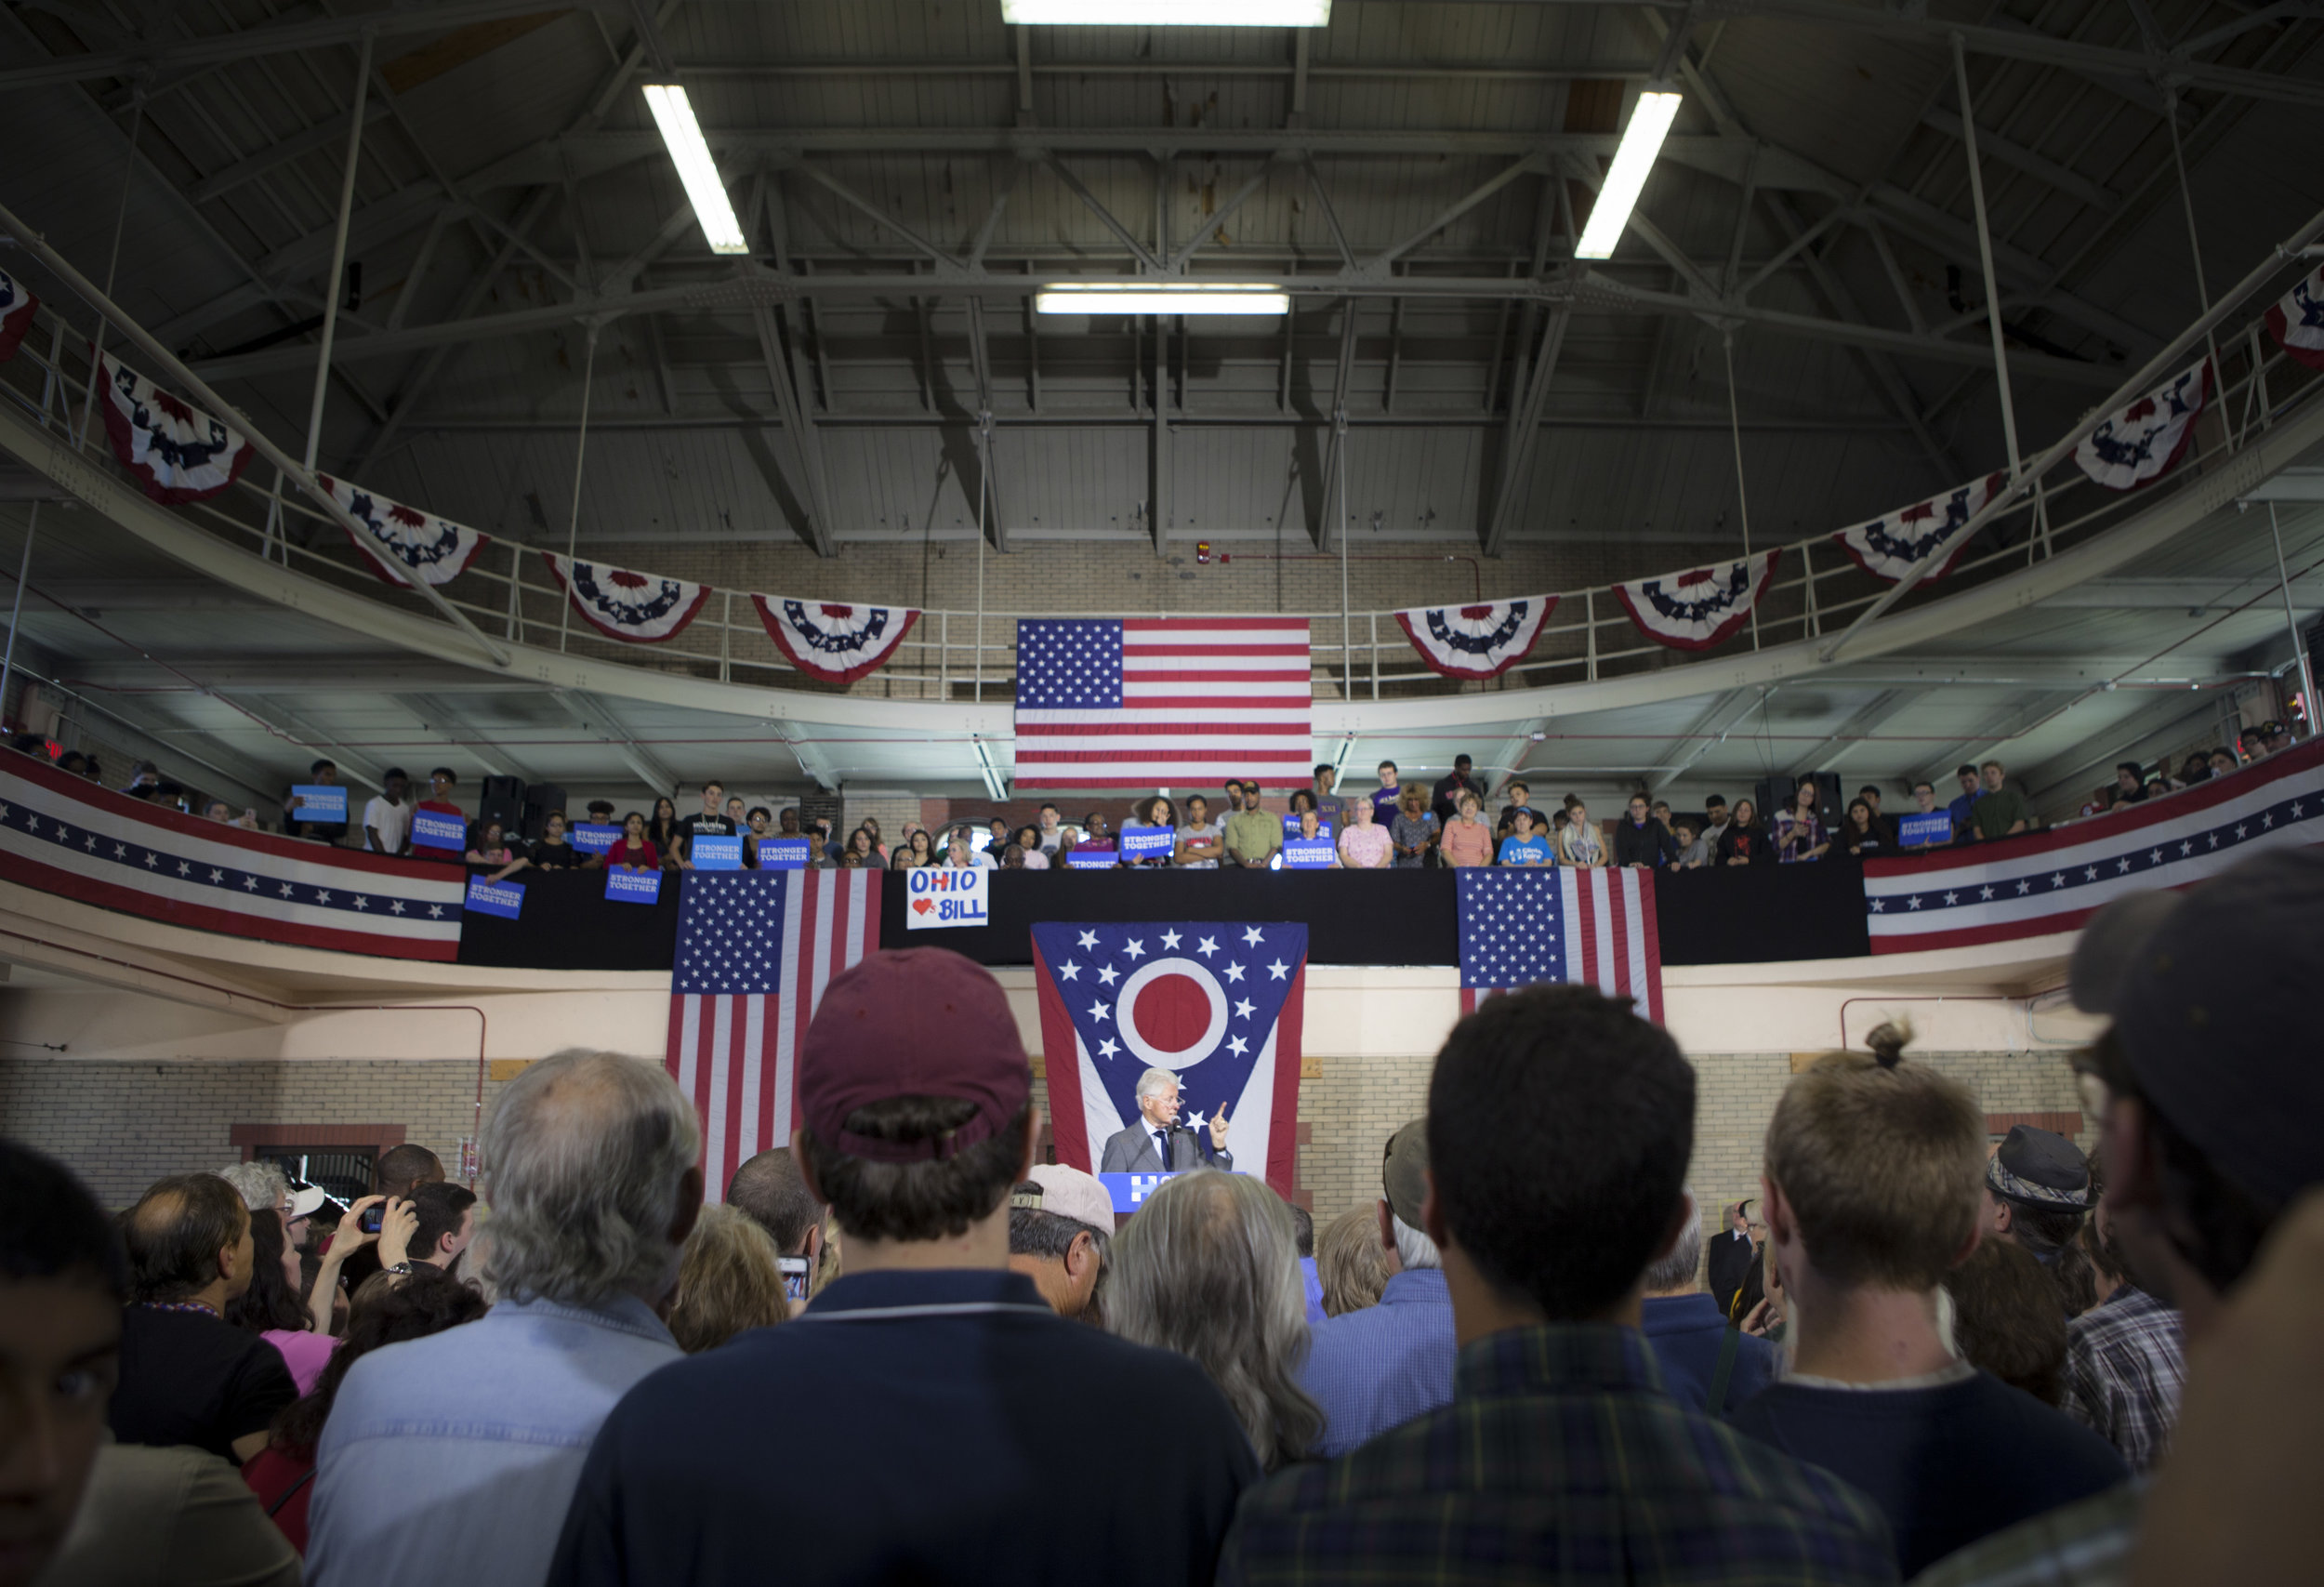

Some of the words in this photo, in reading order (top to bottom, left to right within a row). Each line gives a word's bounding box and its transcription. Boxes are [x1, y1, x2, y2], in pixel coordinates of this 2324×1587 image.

[416, 817, 465, 832] STRONGER
[1902, 817, 1949, 829] STRONGER
[416, 825, 464, 840] TOGETHER
[1902, 825, 1949, 836] TOGETHER
[1124, 833, 1170, 843] STRONGER
[694, 844, 740, 853] STRONGER
[1124, 840, 1170, 850] TOGETHER
[694, 852, 739, 860] TOGETHER
[1287, 847, 1333, 856] STRONGER
[1287, 854, 1333, 863] TOGETHER
[611, 874, 658, 886] STRONGER
[910, 869, 978, 893] OHIO
[470, 884, 521, 901] STRONGER
[610, 881, 657, 893] TOGETHER
[469, 892, 520, 907] TOGETHER
[938, 898, 987, 920] BILL
